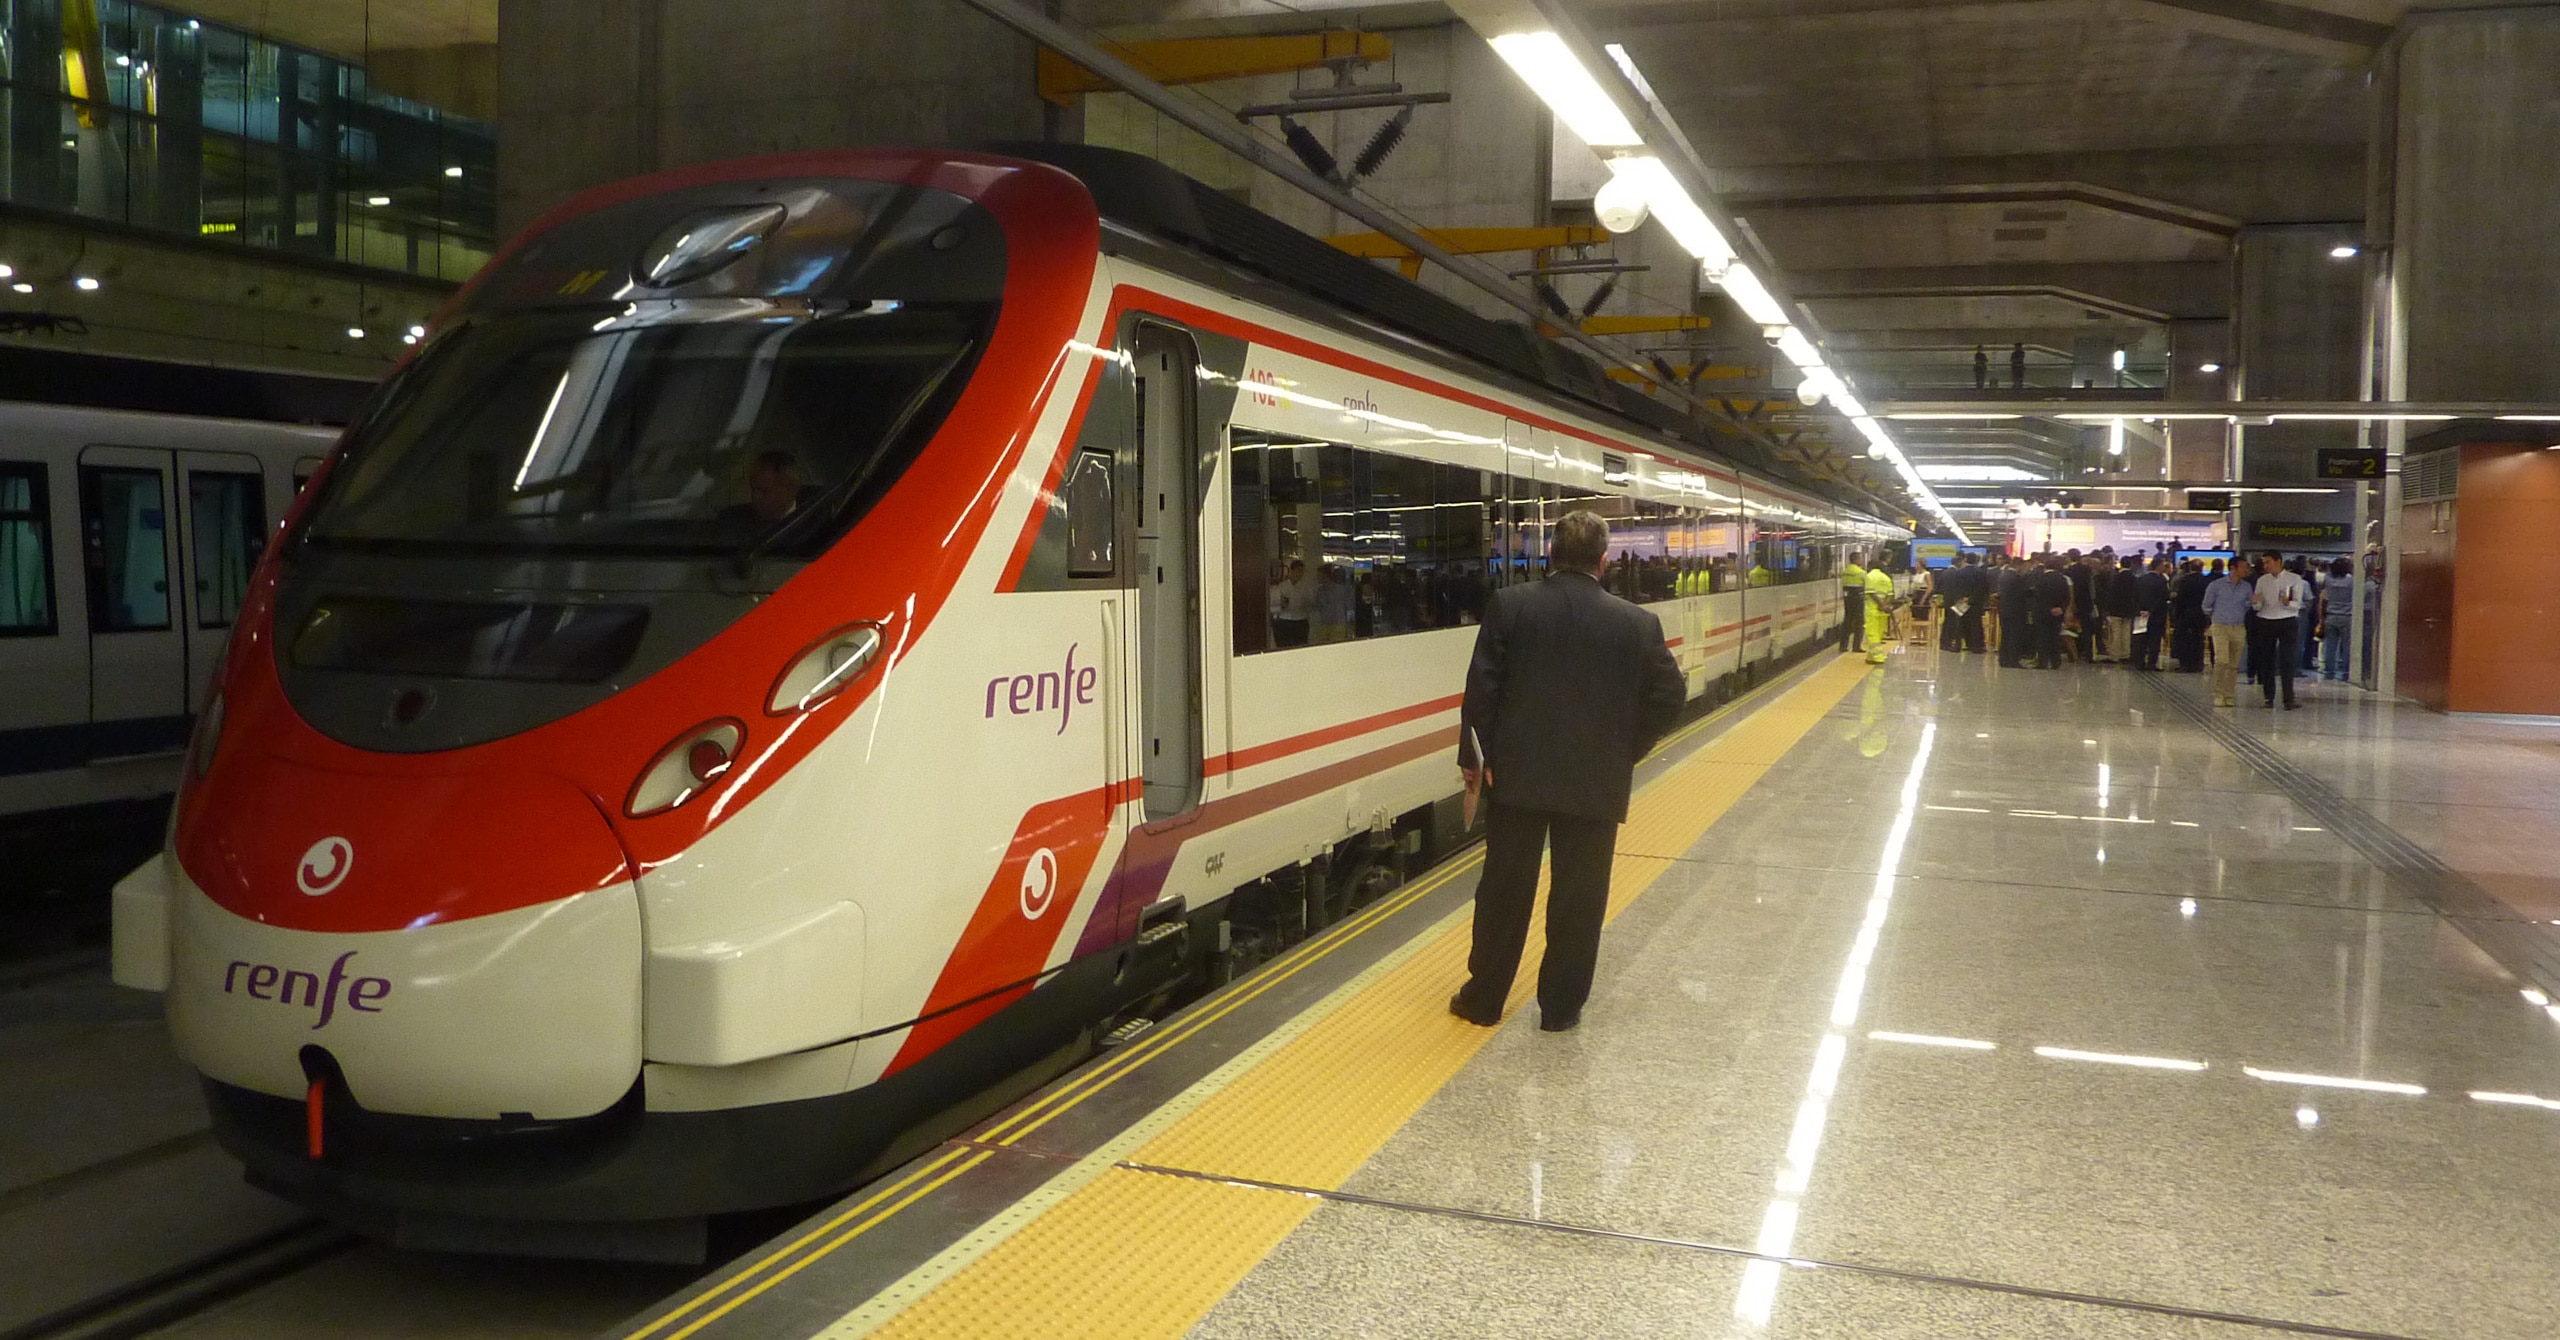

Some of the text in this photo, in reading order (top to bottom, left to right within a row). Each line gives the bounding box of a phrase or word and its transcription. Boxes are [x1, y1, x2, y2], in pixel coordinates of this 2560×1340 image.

[556, 270, 608, 296] M
[1249, 367, 1276, 407] 102
[1343, 389, 1378, 434] renfe
[2362, 458, 2376, 475] 2
[2217, 497, 2226, 508] 2
[2259, 525, 2342, 537] Aeropuerto T4
[985, 641, 1097, 736] renfe
[1204, 851, 1226, 878] CAF
[224, 951, 392, 1030] renfe
